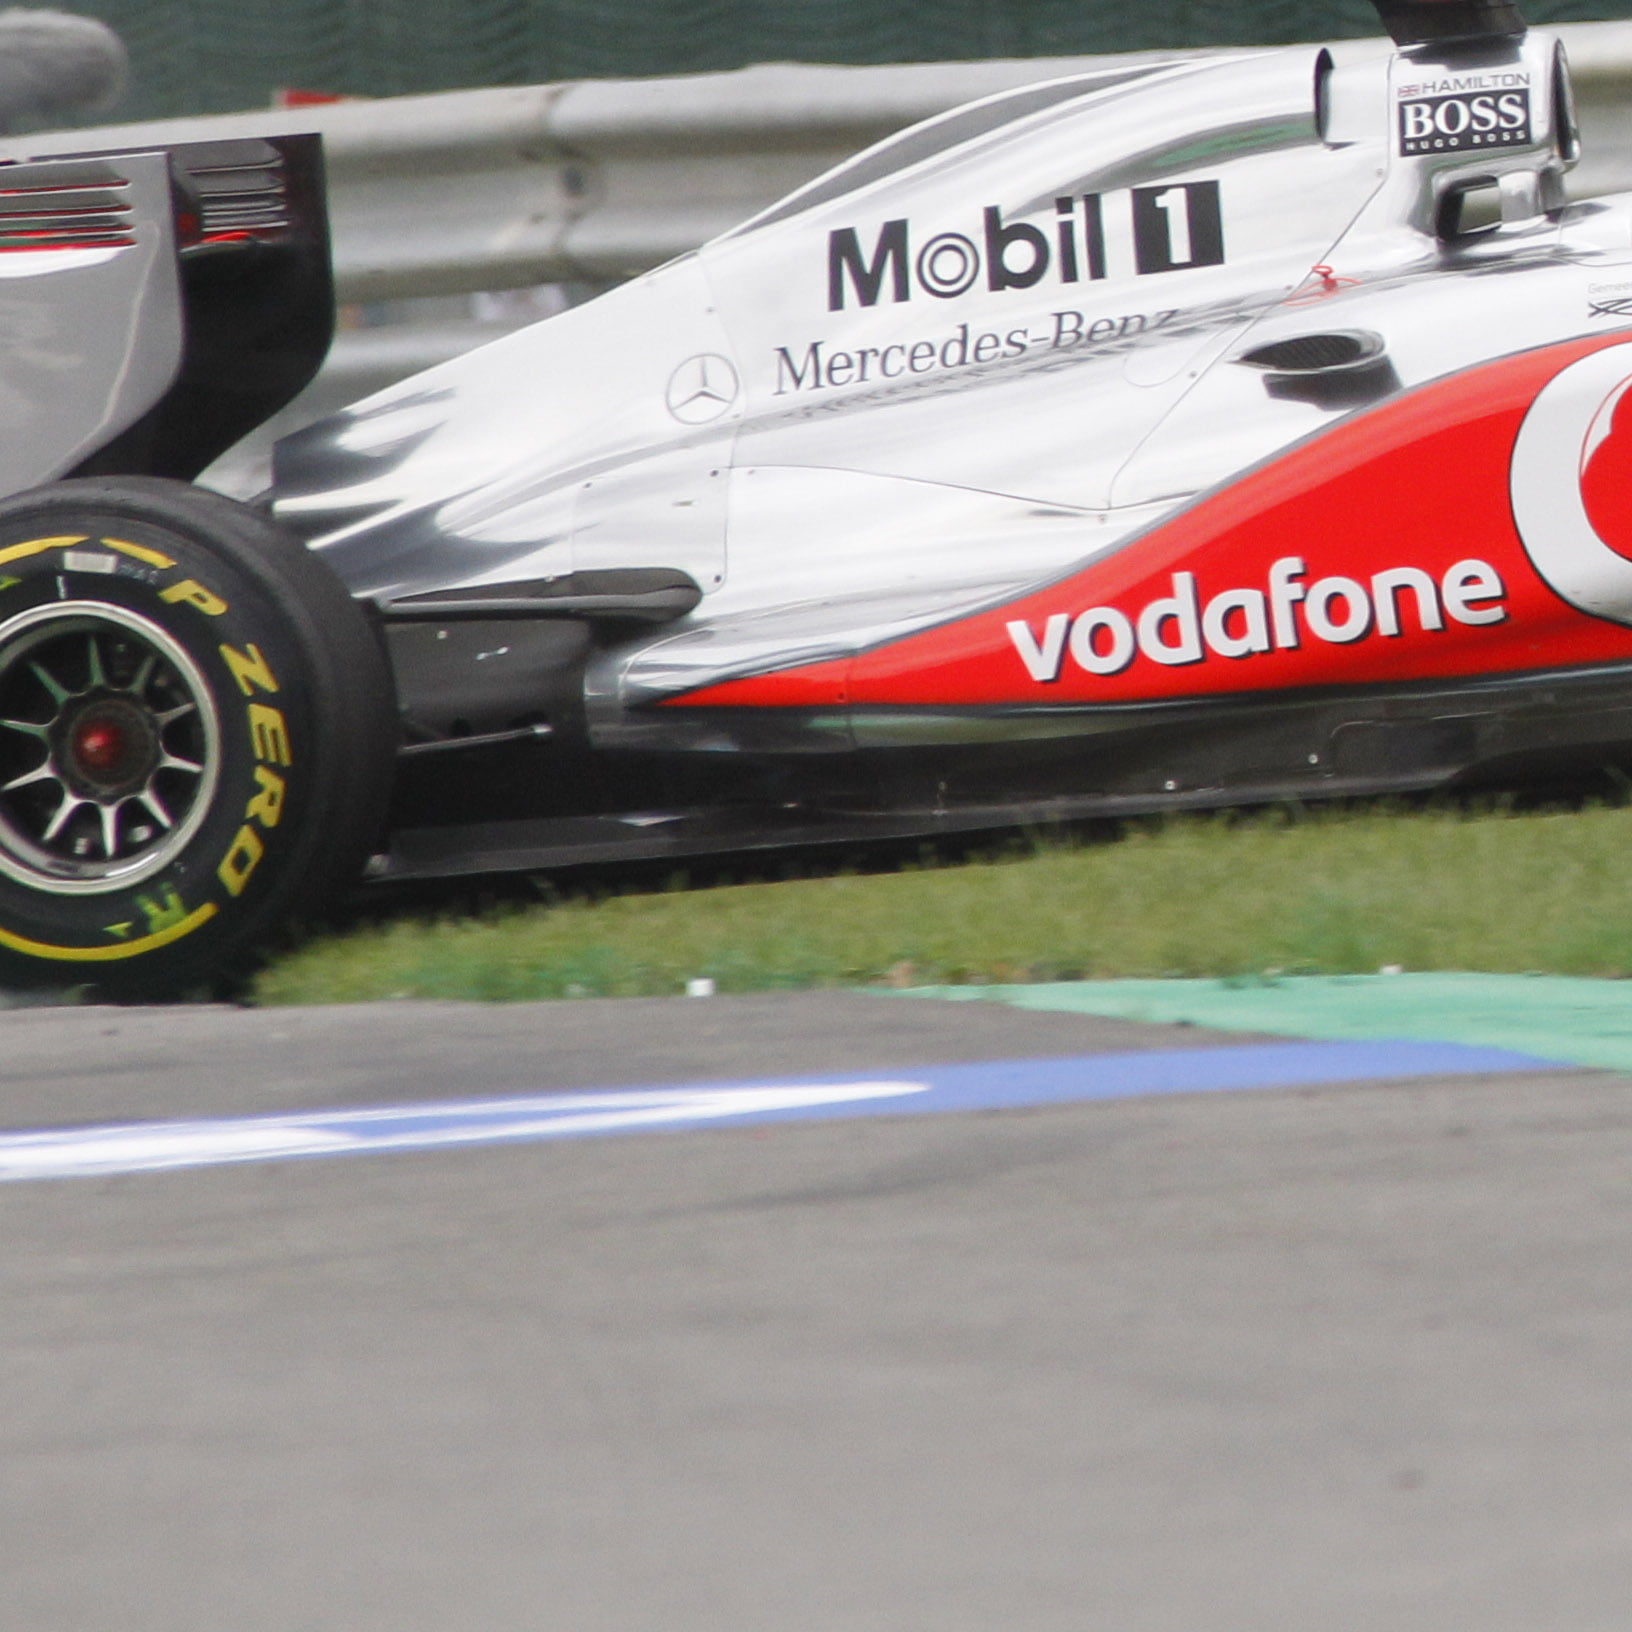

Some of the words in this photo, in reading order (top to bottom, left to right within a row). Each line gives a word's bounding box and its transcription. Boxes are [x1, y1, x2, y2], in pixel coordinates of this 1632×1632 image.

[1404, 93, 1527, 139] BOSS
[1422, 72, 1531, 94] HAMILTON
[1406, 137, 1460, 151] HUGO
[1472, 129, 1527, 144] BOSS
[827, 192, 1107, 313] Mobil
[772, 310, 1179, 396] Mercedes-Benz
[1005, 555, 1508, 682] vodafone
[158, 578, 229, 617] P
[217, 642, 292, 898] ZERO
